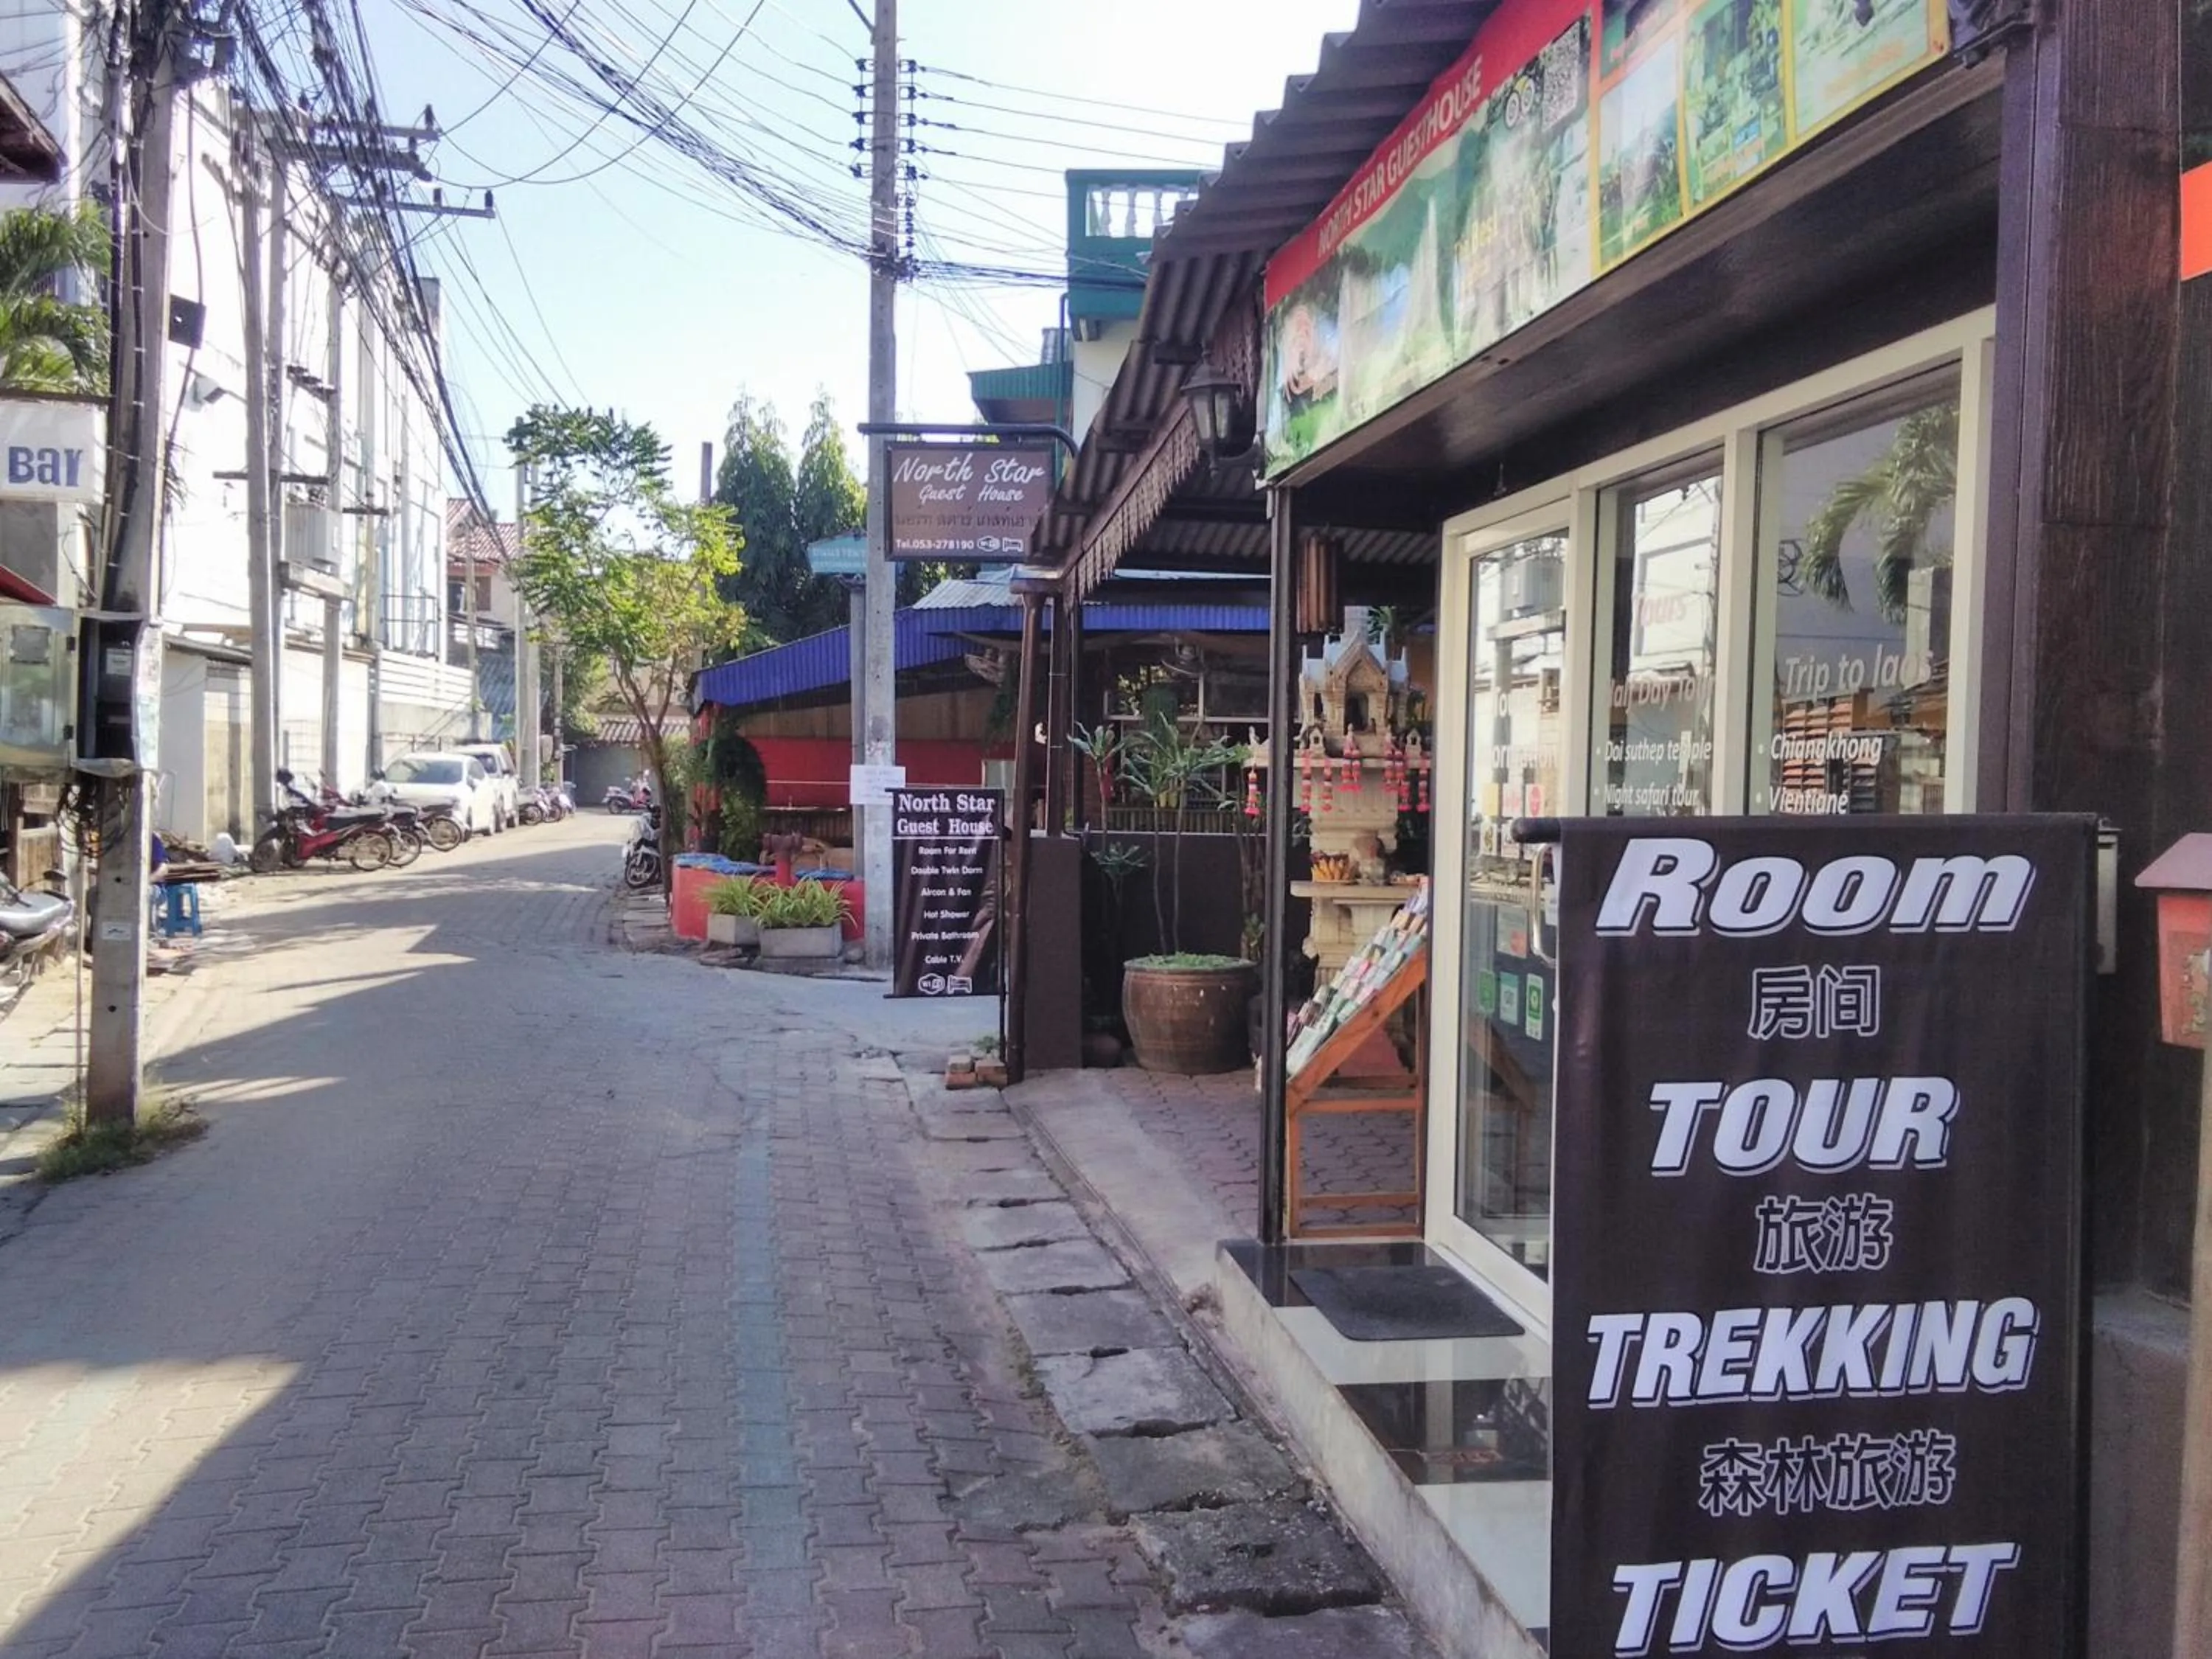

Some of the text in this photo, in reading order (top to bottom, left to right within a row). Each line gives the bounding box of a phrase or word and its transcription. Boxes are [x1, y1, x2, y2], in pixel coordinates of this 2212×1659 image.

[1354, 162, 1385, 220] STAR
[7, 445, 84, 487] Bar
[893, 451, 1046, 484] North Star
[919, 484, 1025, 504] Guest House
[1784, 643, 1934, 703] Trip to laos
[1638, 680, 1672, 712] Day
[1604, 740, 1624, 762] Doi
[1624, 737, 1665, 766] suthep
[1770, 732, 1883, 766] Chiangkhong
[897, 793, 995, 813] North Star
[1603, 782, 1634, 810] Night
[1635, 784, 1670, 812] safari
[897, 818, 994, 835] Guest House
[918, 846, 942, 855] Room
[911, 866, 940, 875] Double
[941, 866, 960, 874] Twin
[921, 887, 947, 897] Aircon
[1595, 837, 2037, 938] Room
[923, 910, 970, 919] Hot Shower
[911, 931, 980, 940] Private Bathroom
[925, 955, 947, 964] Cable
[1747, 962, 1882, 1040] 房间
[1649, 1075, 1961, 1177] TOUR
[1753, 1192, 1895, 1274] 旅游
[1587, 1296, 2041, 1409] TREKKING
[1699, 1428, 1957, 1517] 森林旅游
[1613, 1542, 2022, 1658] TICKET
